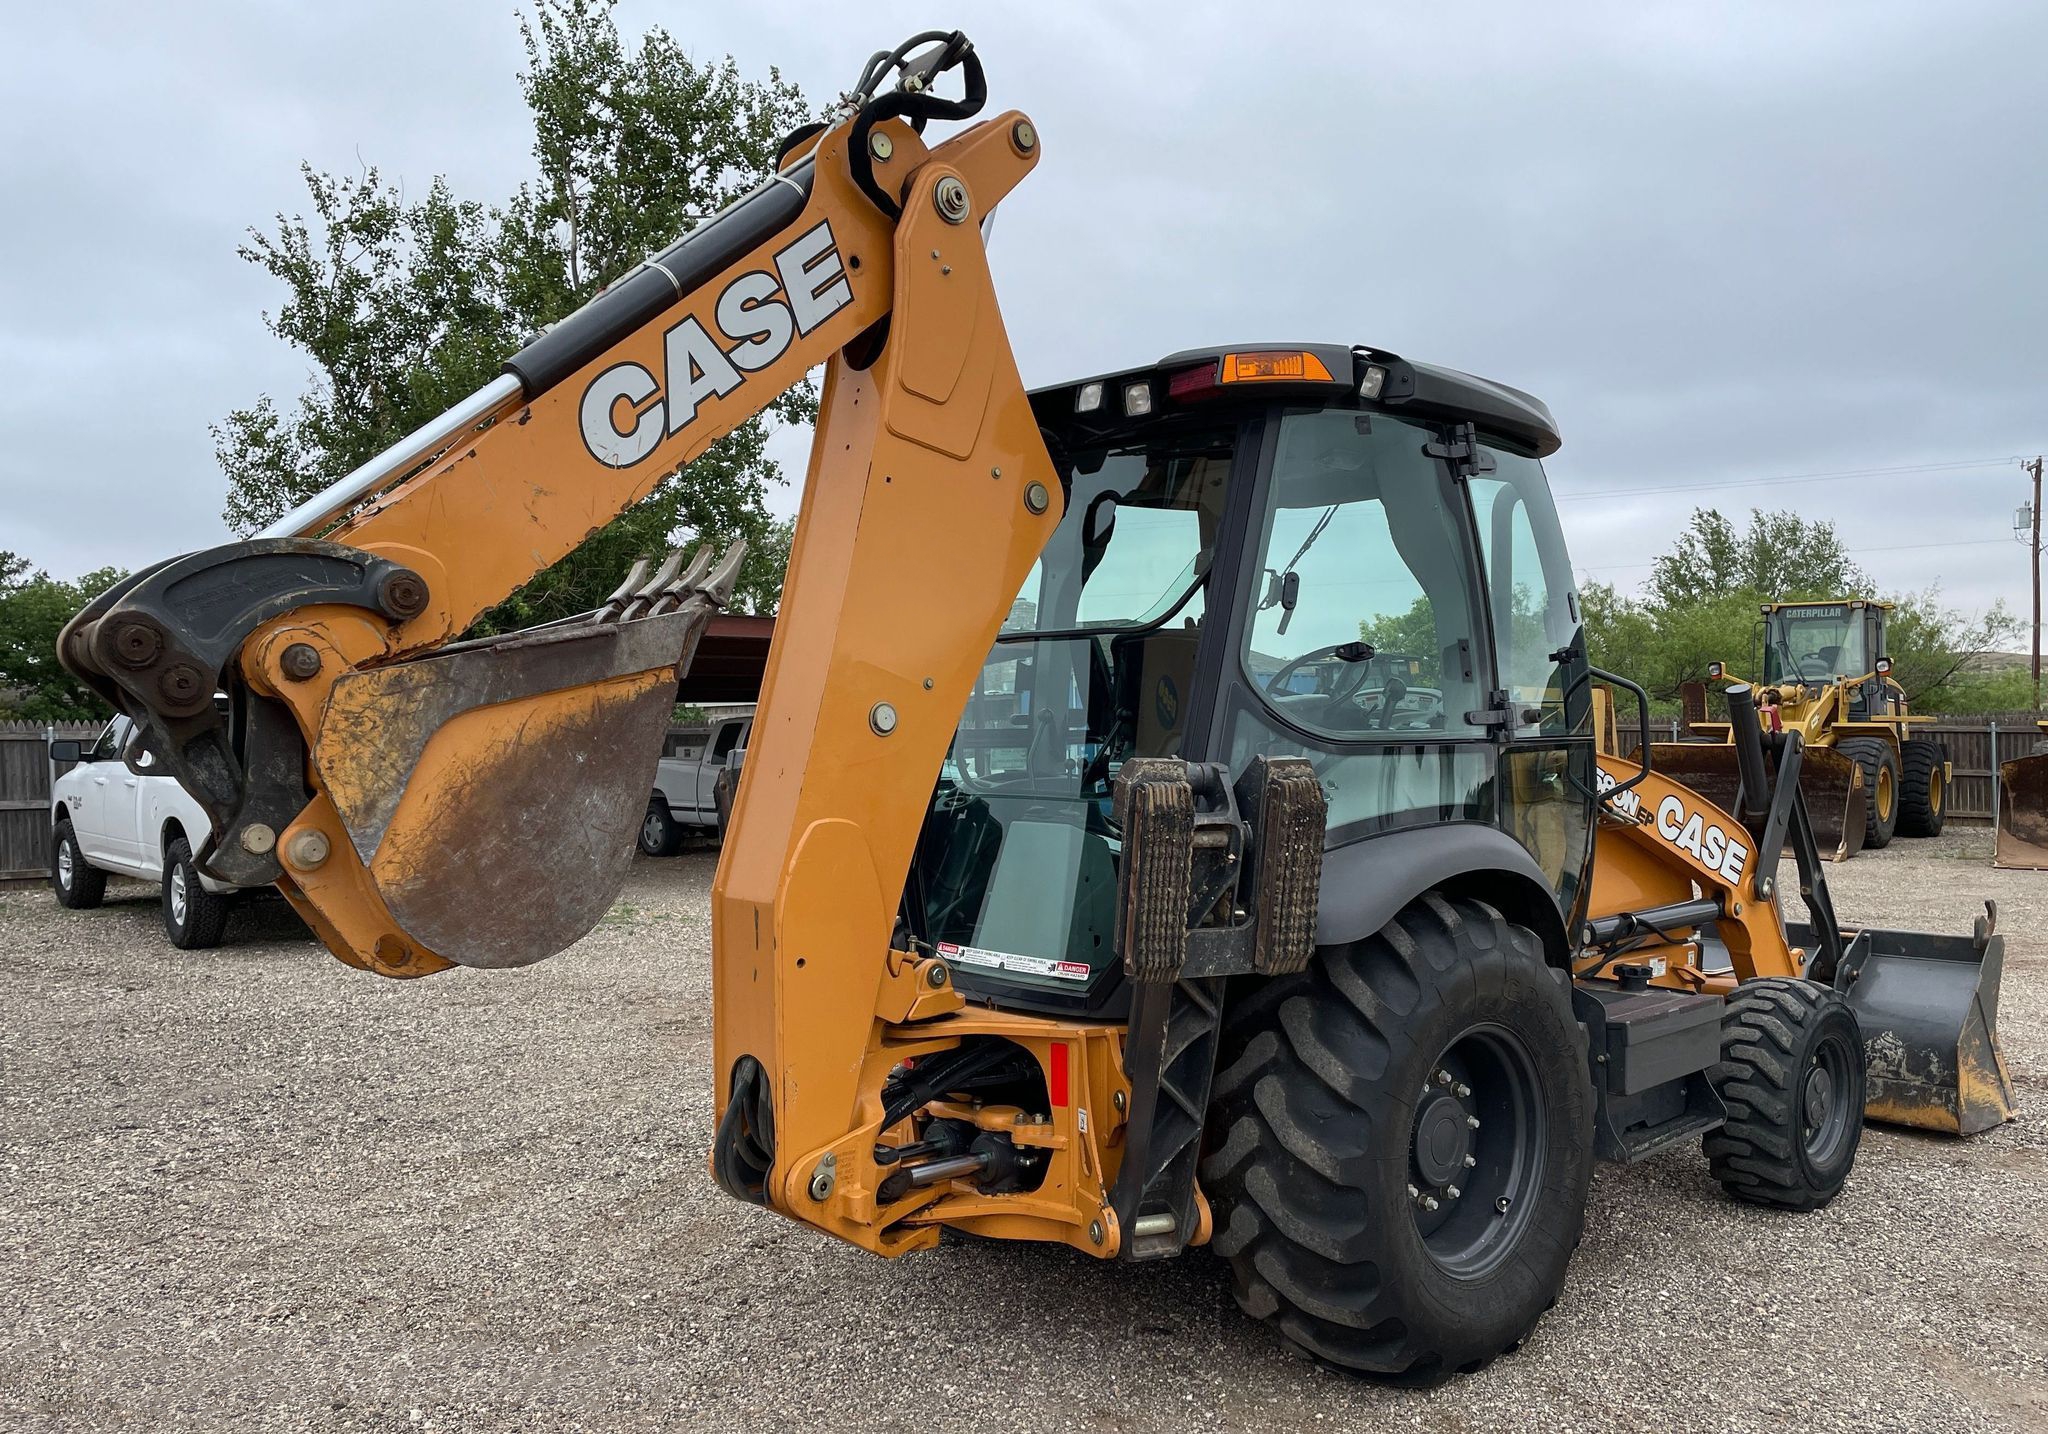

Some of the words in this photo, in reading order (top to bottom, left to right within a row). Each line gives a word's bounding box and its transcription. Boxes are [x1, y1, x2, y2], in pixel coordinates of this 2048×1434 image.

[578, 217, 855, 470] CASE
[1786, 607, 1842, 618] CATERPILLAR
[1636, 805, 1655, 826] EP
[1657, 795, 1749, 887] CASE
[1064, 965, 1087, 974] DANGER
